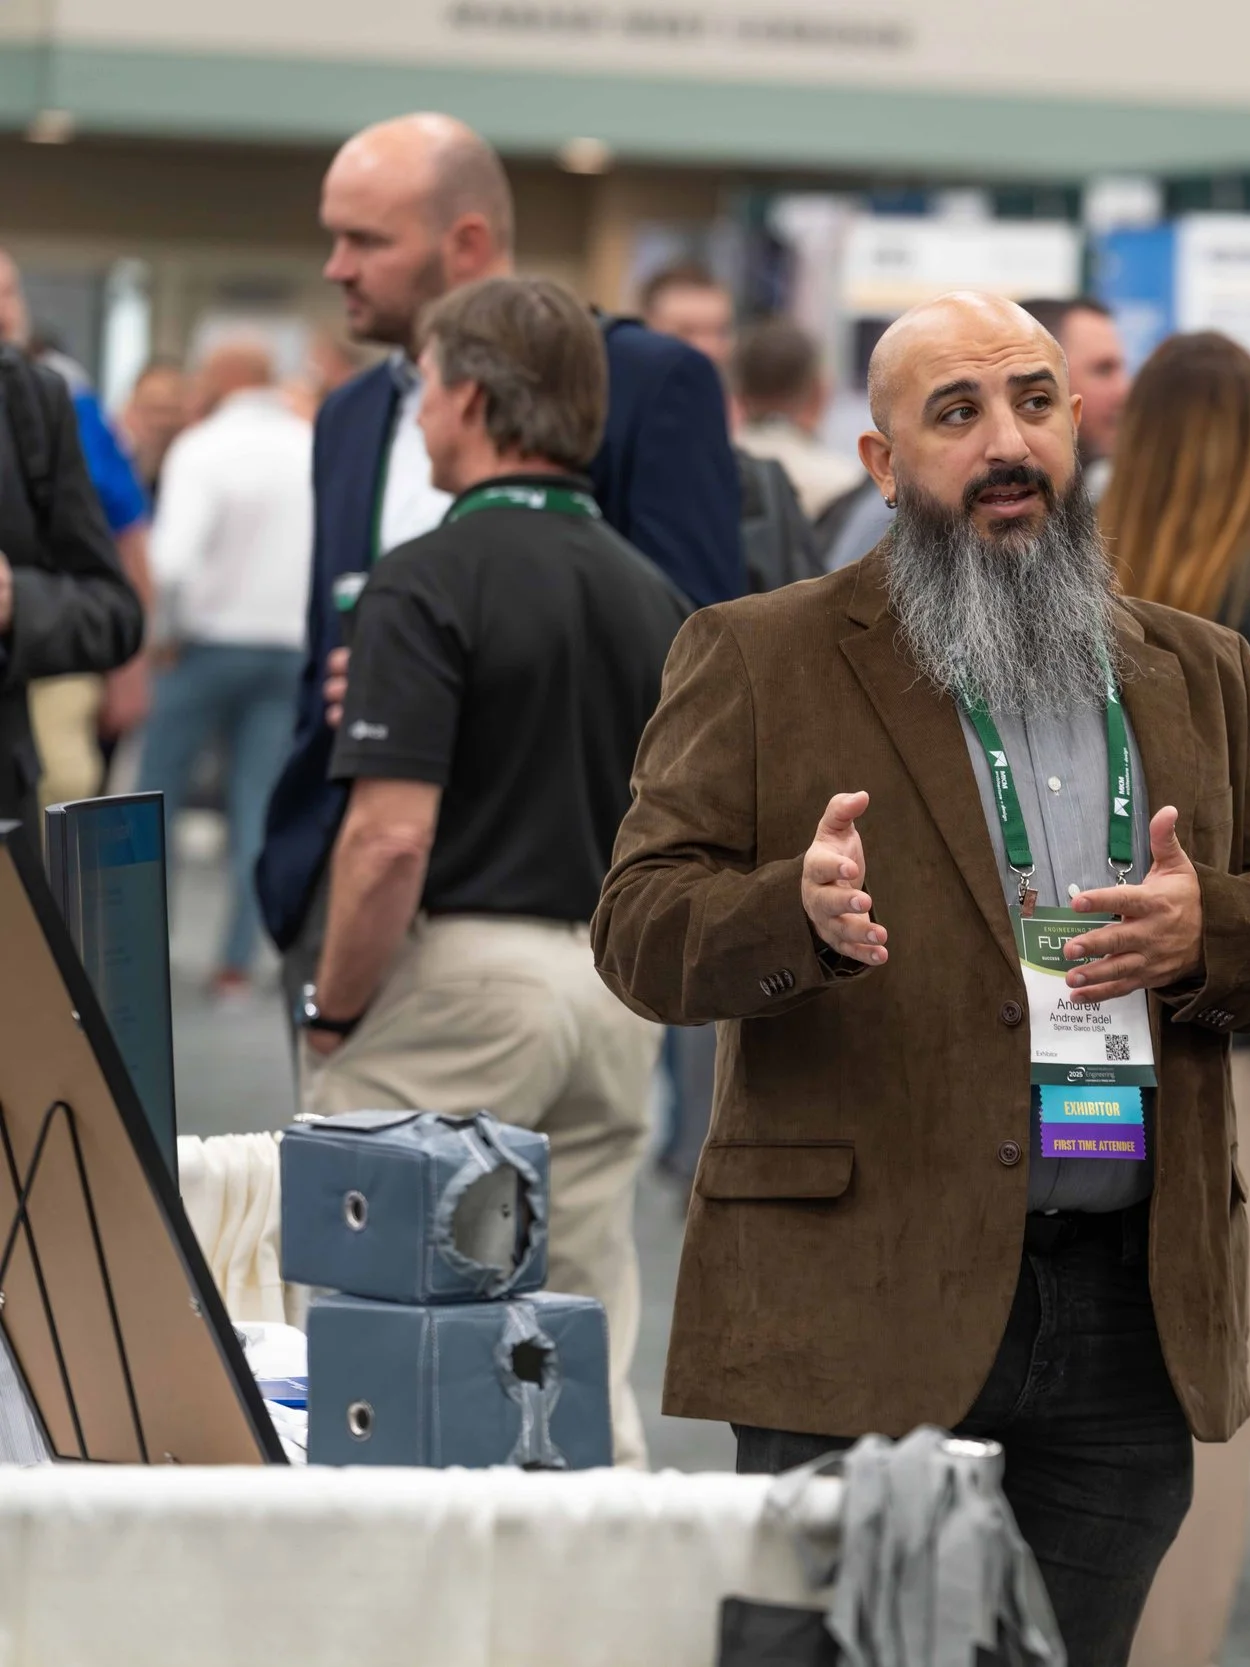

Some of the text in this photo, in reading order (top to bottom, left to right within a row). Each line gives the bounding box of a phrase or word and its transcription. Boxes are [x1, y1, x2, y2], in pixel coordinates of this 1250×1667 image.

[1000, 770, 1009, 789] MKM
[1057, 998, 1101, 1012] Andrew
[1049, 1012, 1112, 1024] Andrew Fadel
[1053, 1023, 1072, 1032] Spirax
[1064, 1101, 1121, 1117] EXHIBITOR
[1053, 1139, 1136, 1153] FIRST TIME ATTENDEE
